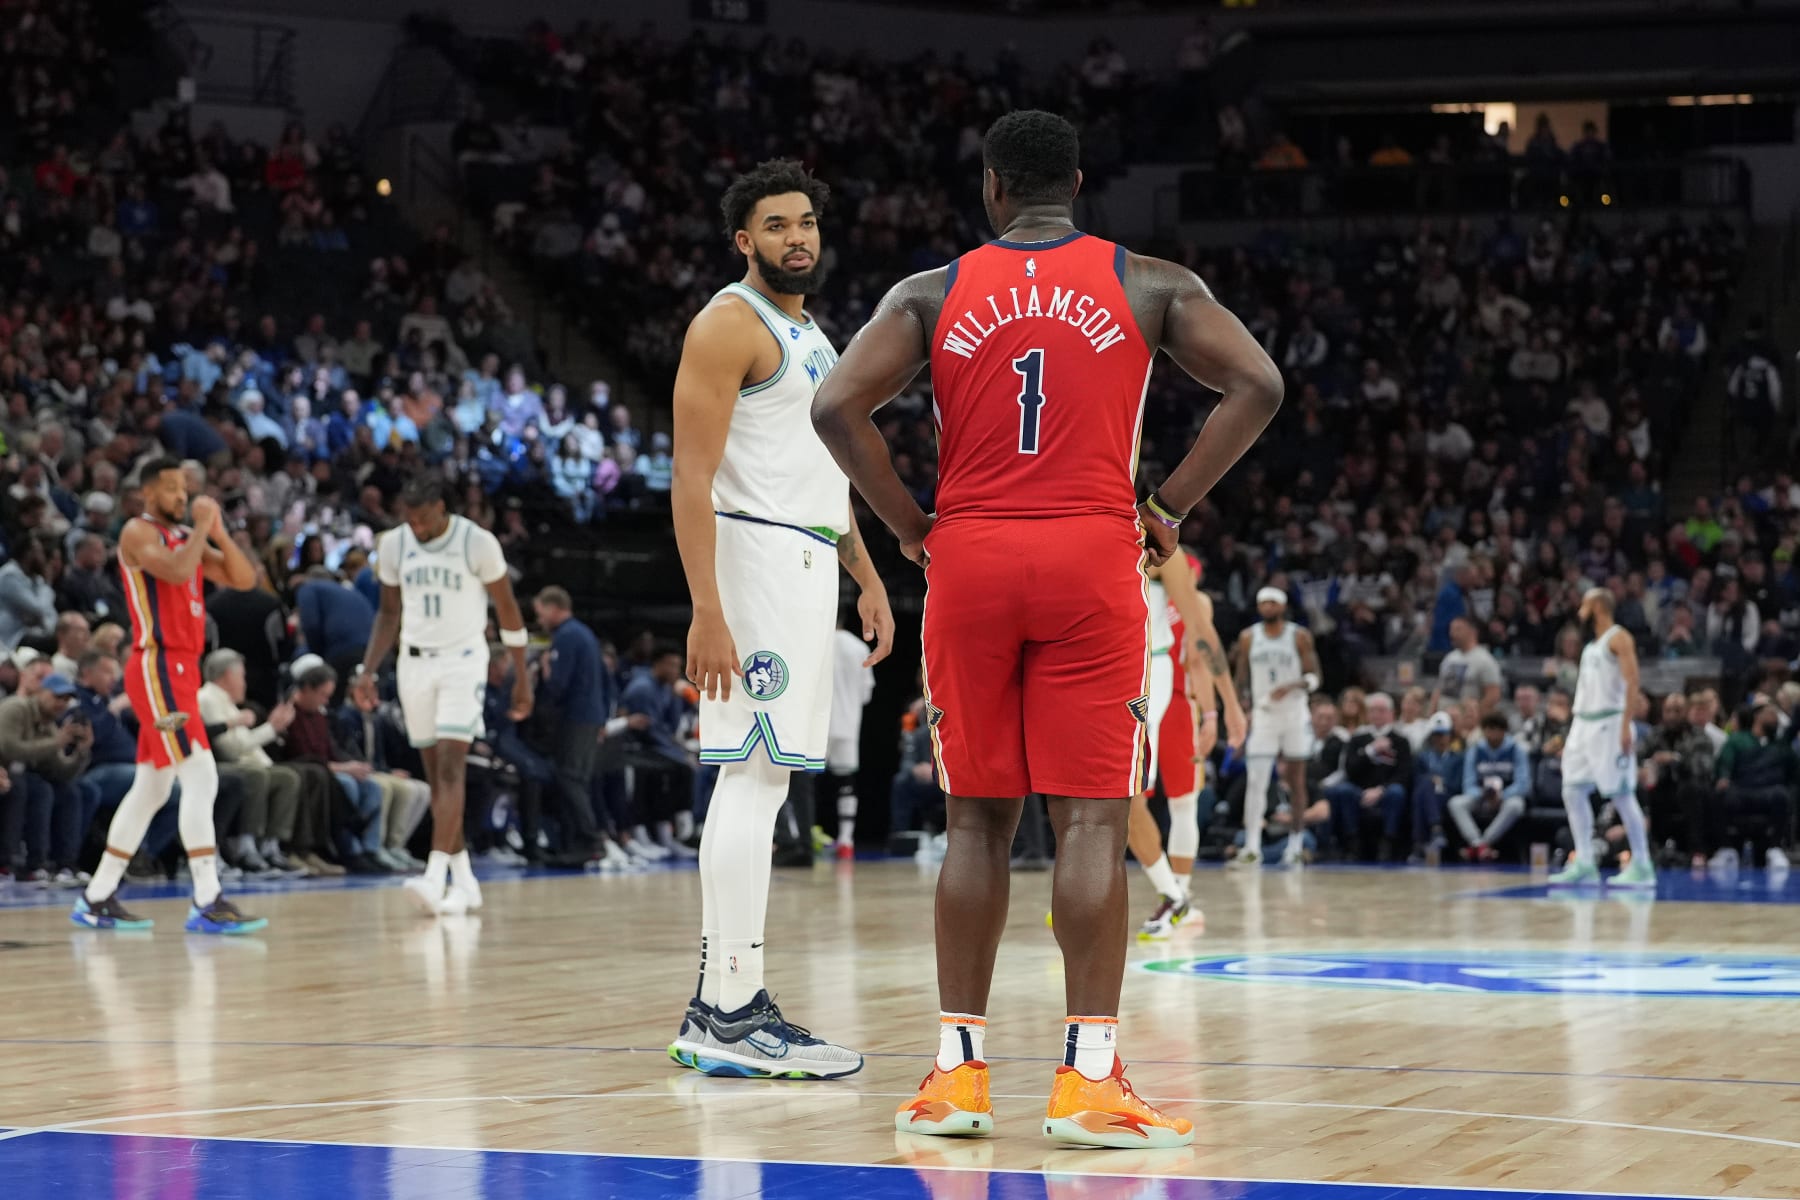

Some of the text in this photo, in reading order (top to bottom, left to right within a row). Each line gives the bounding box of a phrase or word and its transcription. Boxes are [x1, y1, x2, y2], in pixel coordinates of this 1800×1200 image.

[943, 285, 1126, 359] WILLIAMSON
[1012, 348, 1046, 455] 1
[404, 566, 463, 592] WOLVES
[424, 593, 442, 618] 11
